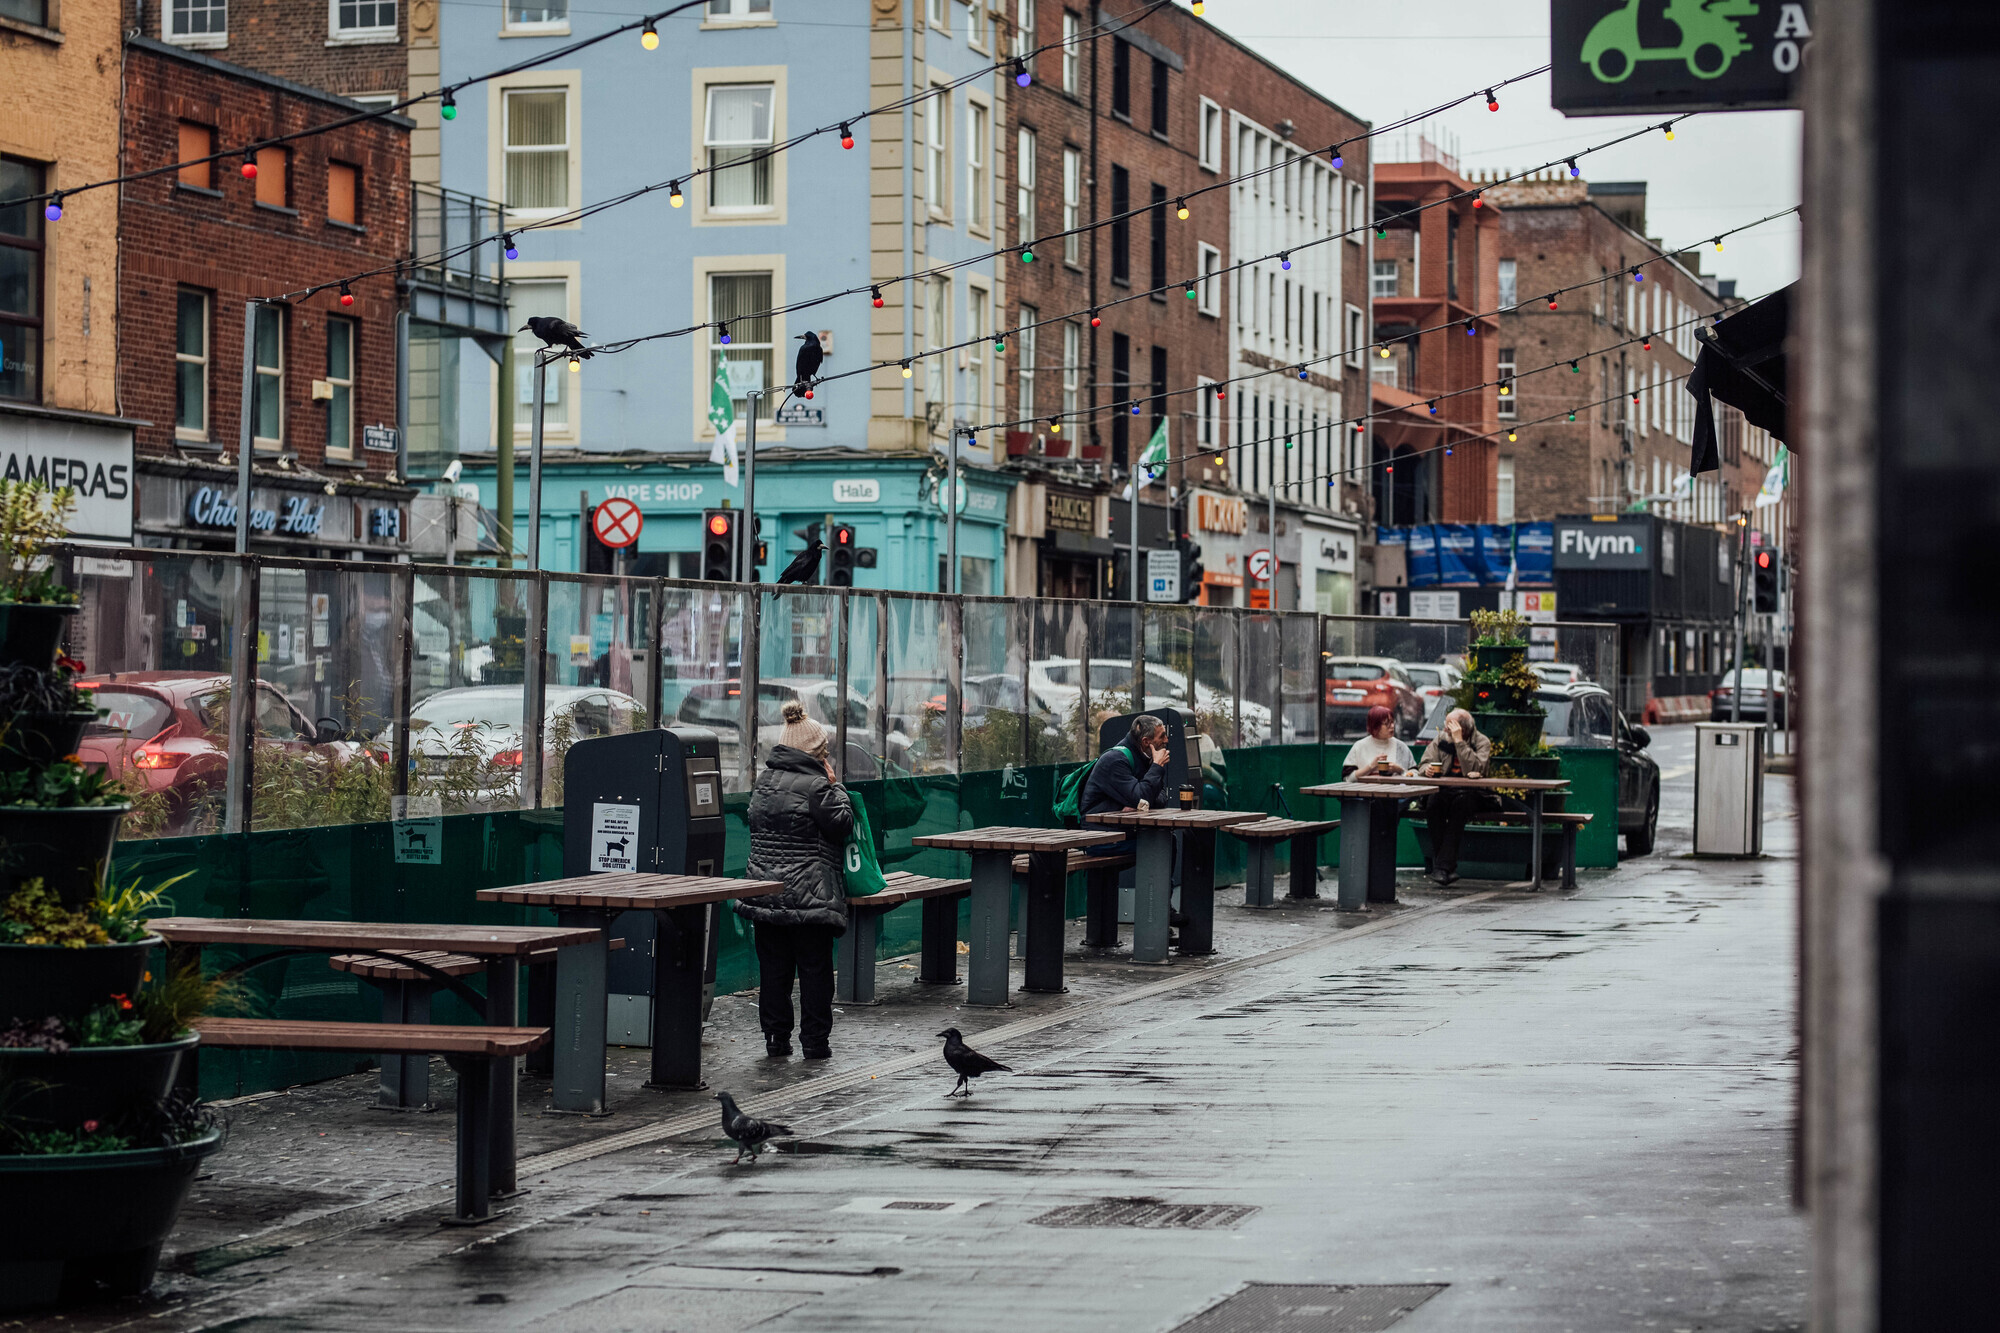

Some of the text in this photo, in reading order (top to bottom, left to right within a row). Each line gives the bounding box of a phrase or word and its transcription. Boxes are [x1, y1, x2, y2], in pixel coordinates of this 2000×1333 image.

[4, 358, 35, 376] Consulting
[0, 452, 128, 500] AMERAS
[604, 484, 703, 501] VAPE SHOP
[840, 484, 873, 497] Hale
[280, 496, 325, 534] Hut
[107, 712, 132, 729] N
